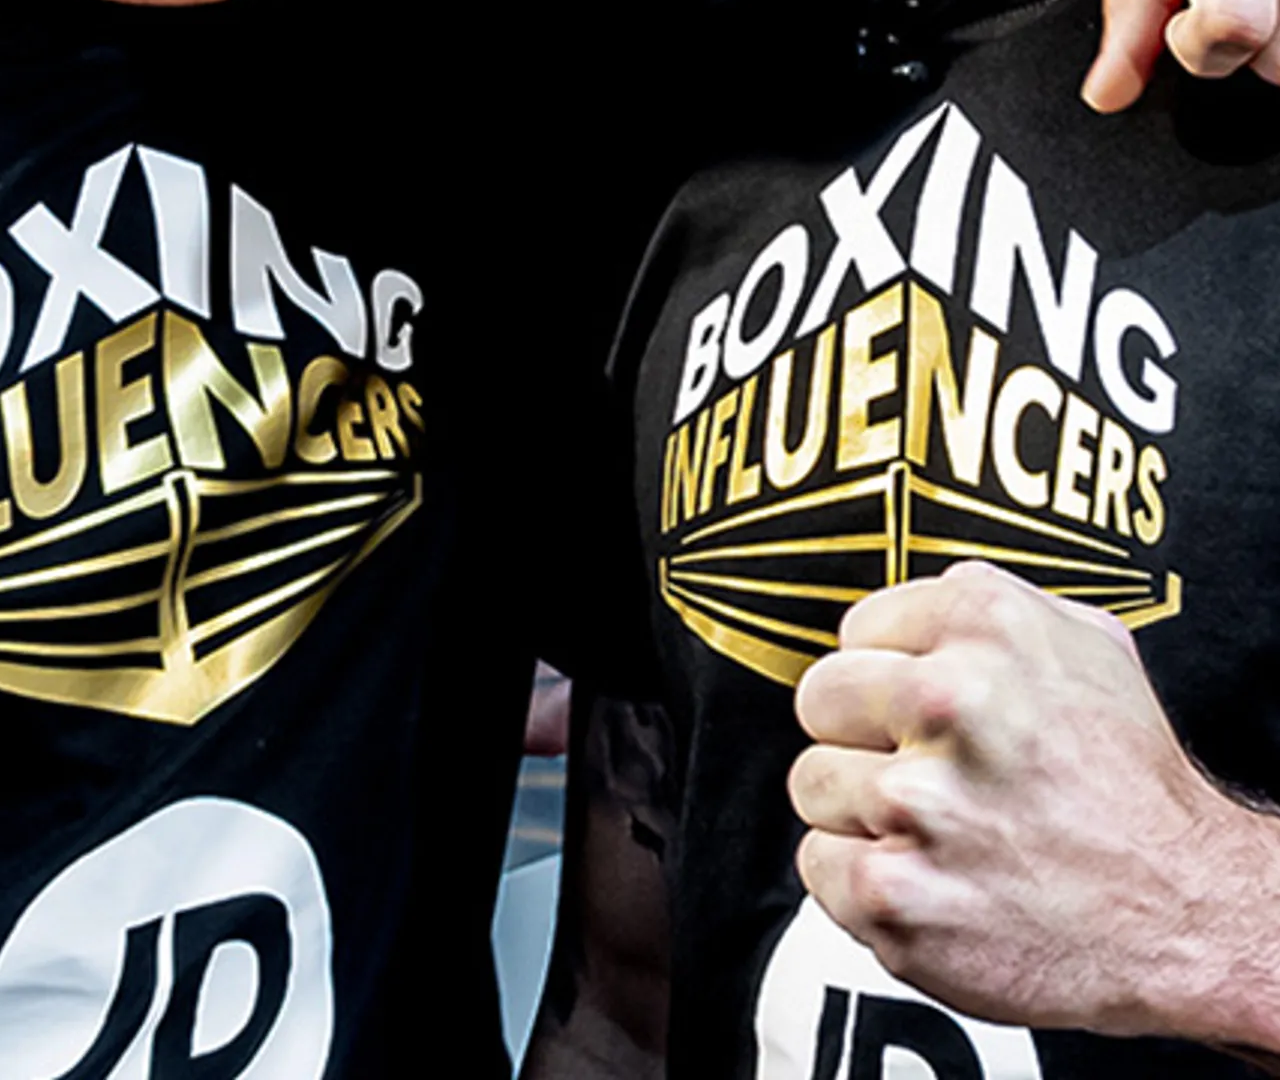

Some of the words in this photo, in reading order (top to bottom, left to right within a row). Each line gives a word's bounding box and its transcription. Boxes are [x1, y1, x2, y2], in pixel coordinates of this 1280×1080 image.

[673, 100, 1179, 434] BOXING
[660, 279, 1168, 545] INFLUENCERS
[52, 893, 296, 1080] JD
